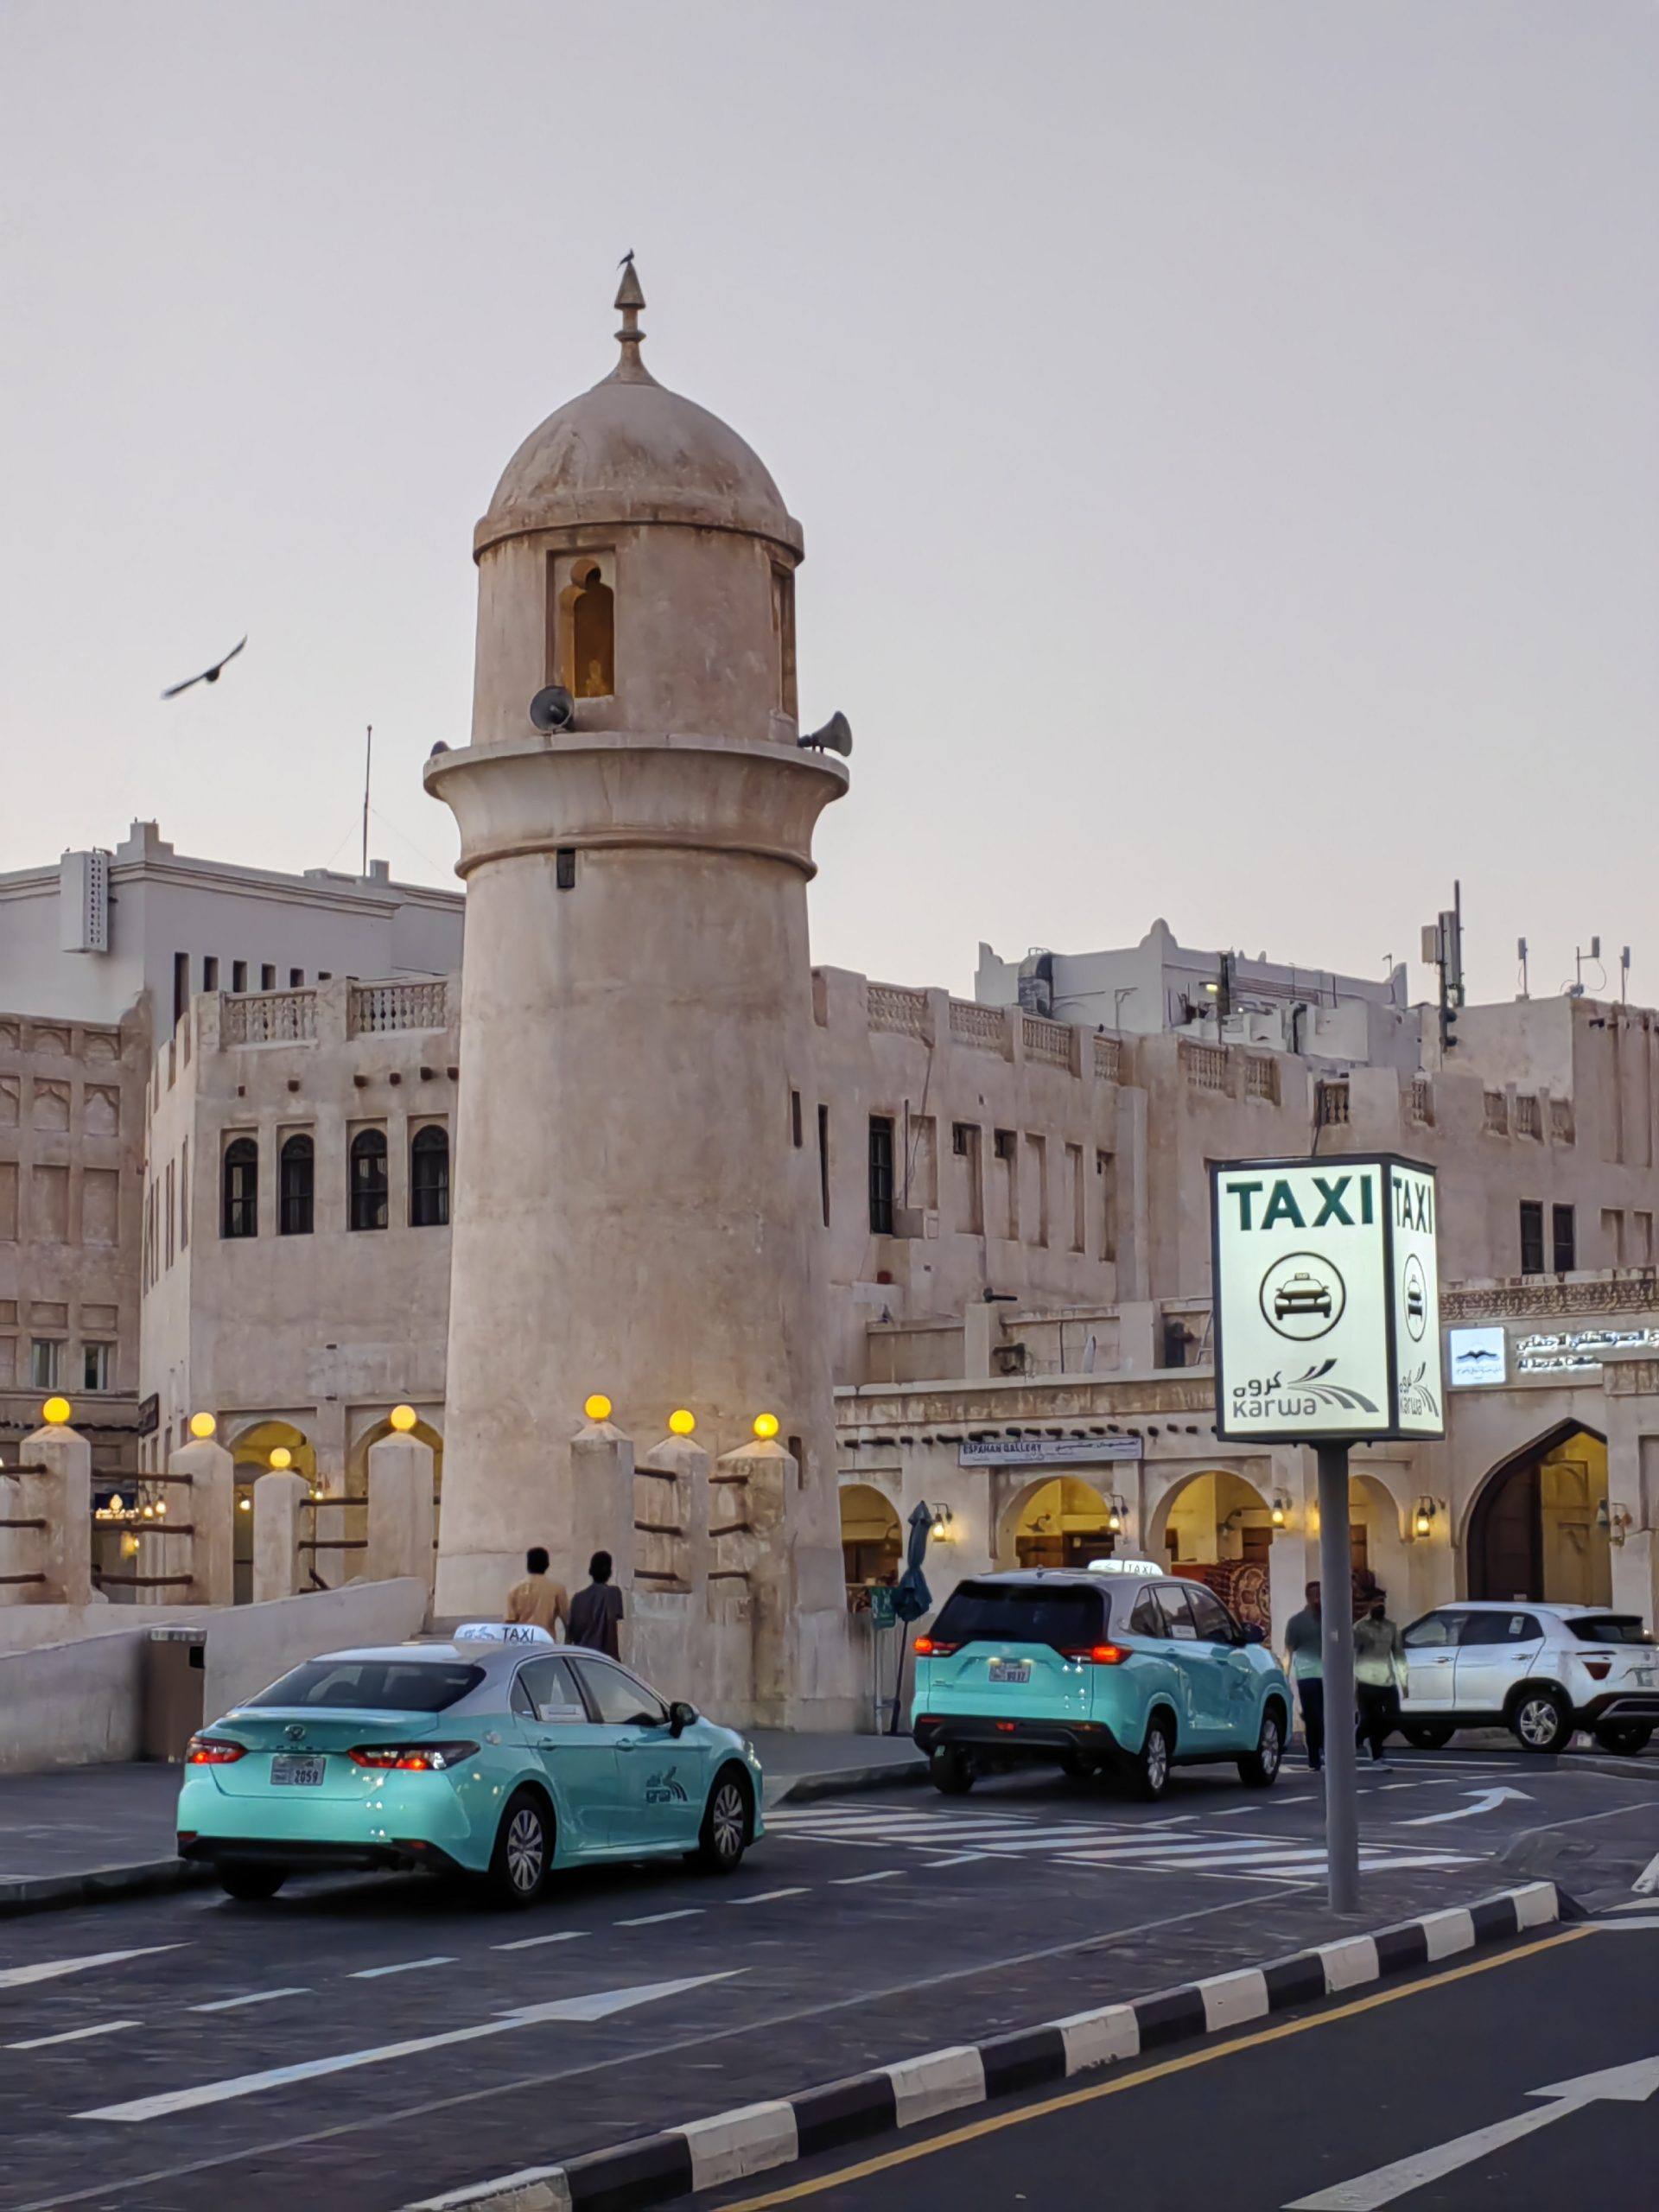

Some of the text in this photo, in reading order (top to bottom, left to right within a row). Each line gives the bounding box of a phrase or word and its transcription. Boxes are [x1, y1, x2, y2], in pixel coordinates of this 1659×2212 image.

[1226, 1175, 1374, 1231] TAXI
[1393, 1177, 1433, 1234] TAXI
[1232, 1370, 1282, 1398] كروه
[1233, 1398, 1317, 1418] karwa
[1004, 1442, 1042, 1452] GALLERY
[1127, 1564, 1154, 1575] TAXI
[502, 1627, 535, 1643] TAXI
